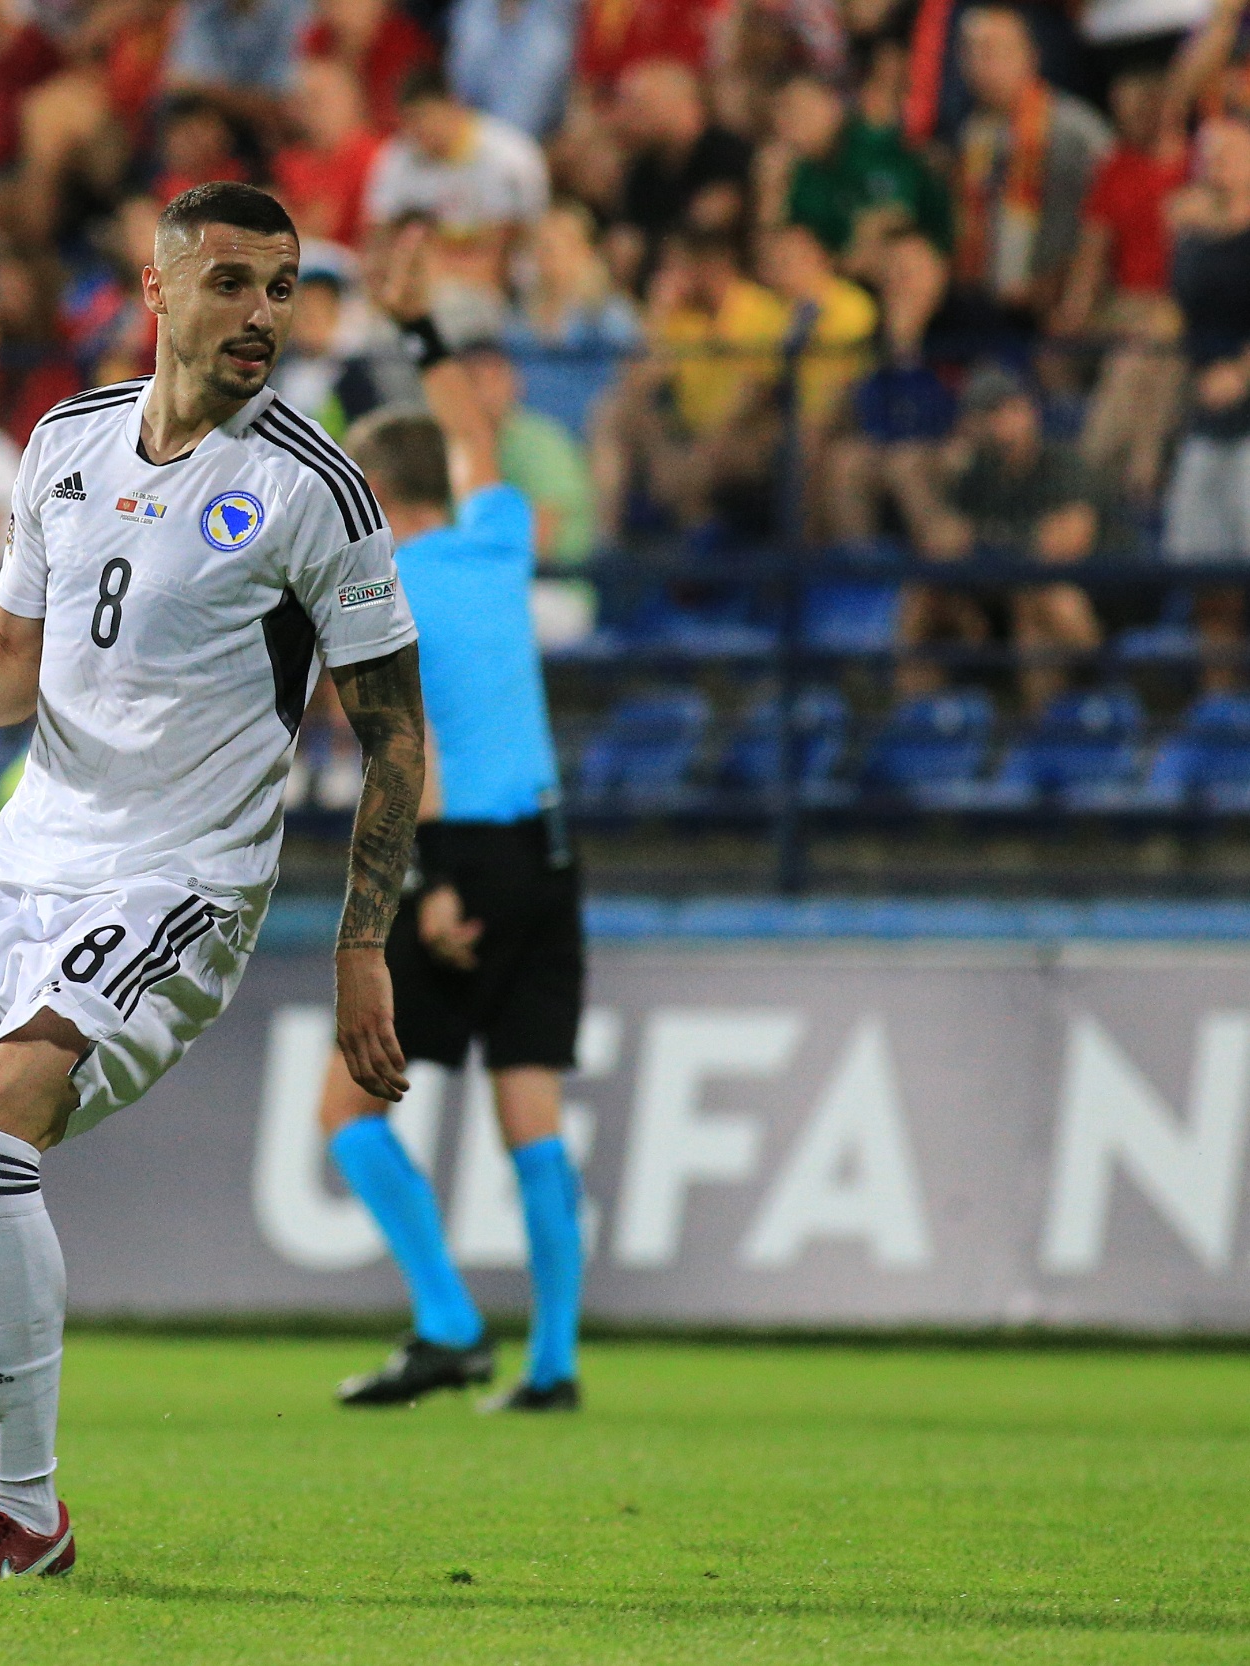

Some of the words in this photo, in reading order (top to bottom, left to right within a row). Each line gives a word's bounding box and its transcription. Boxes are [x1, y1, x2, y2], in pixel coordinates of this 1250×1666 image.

[51, 487, 87, 501] adidas
[90, 557, 132, 649] 8
[339, 582, 396, 604] FOUNDAT
[61, 924, 127, 984] 8
